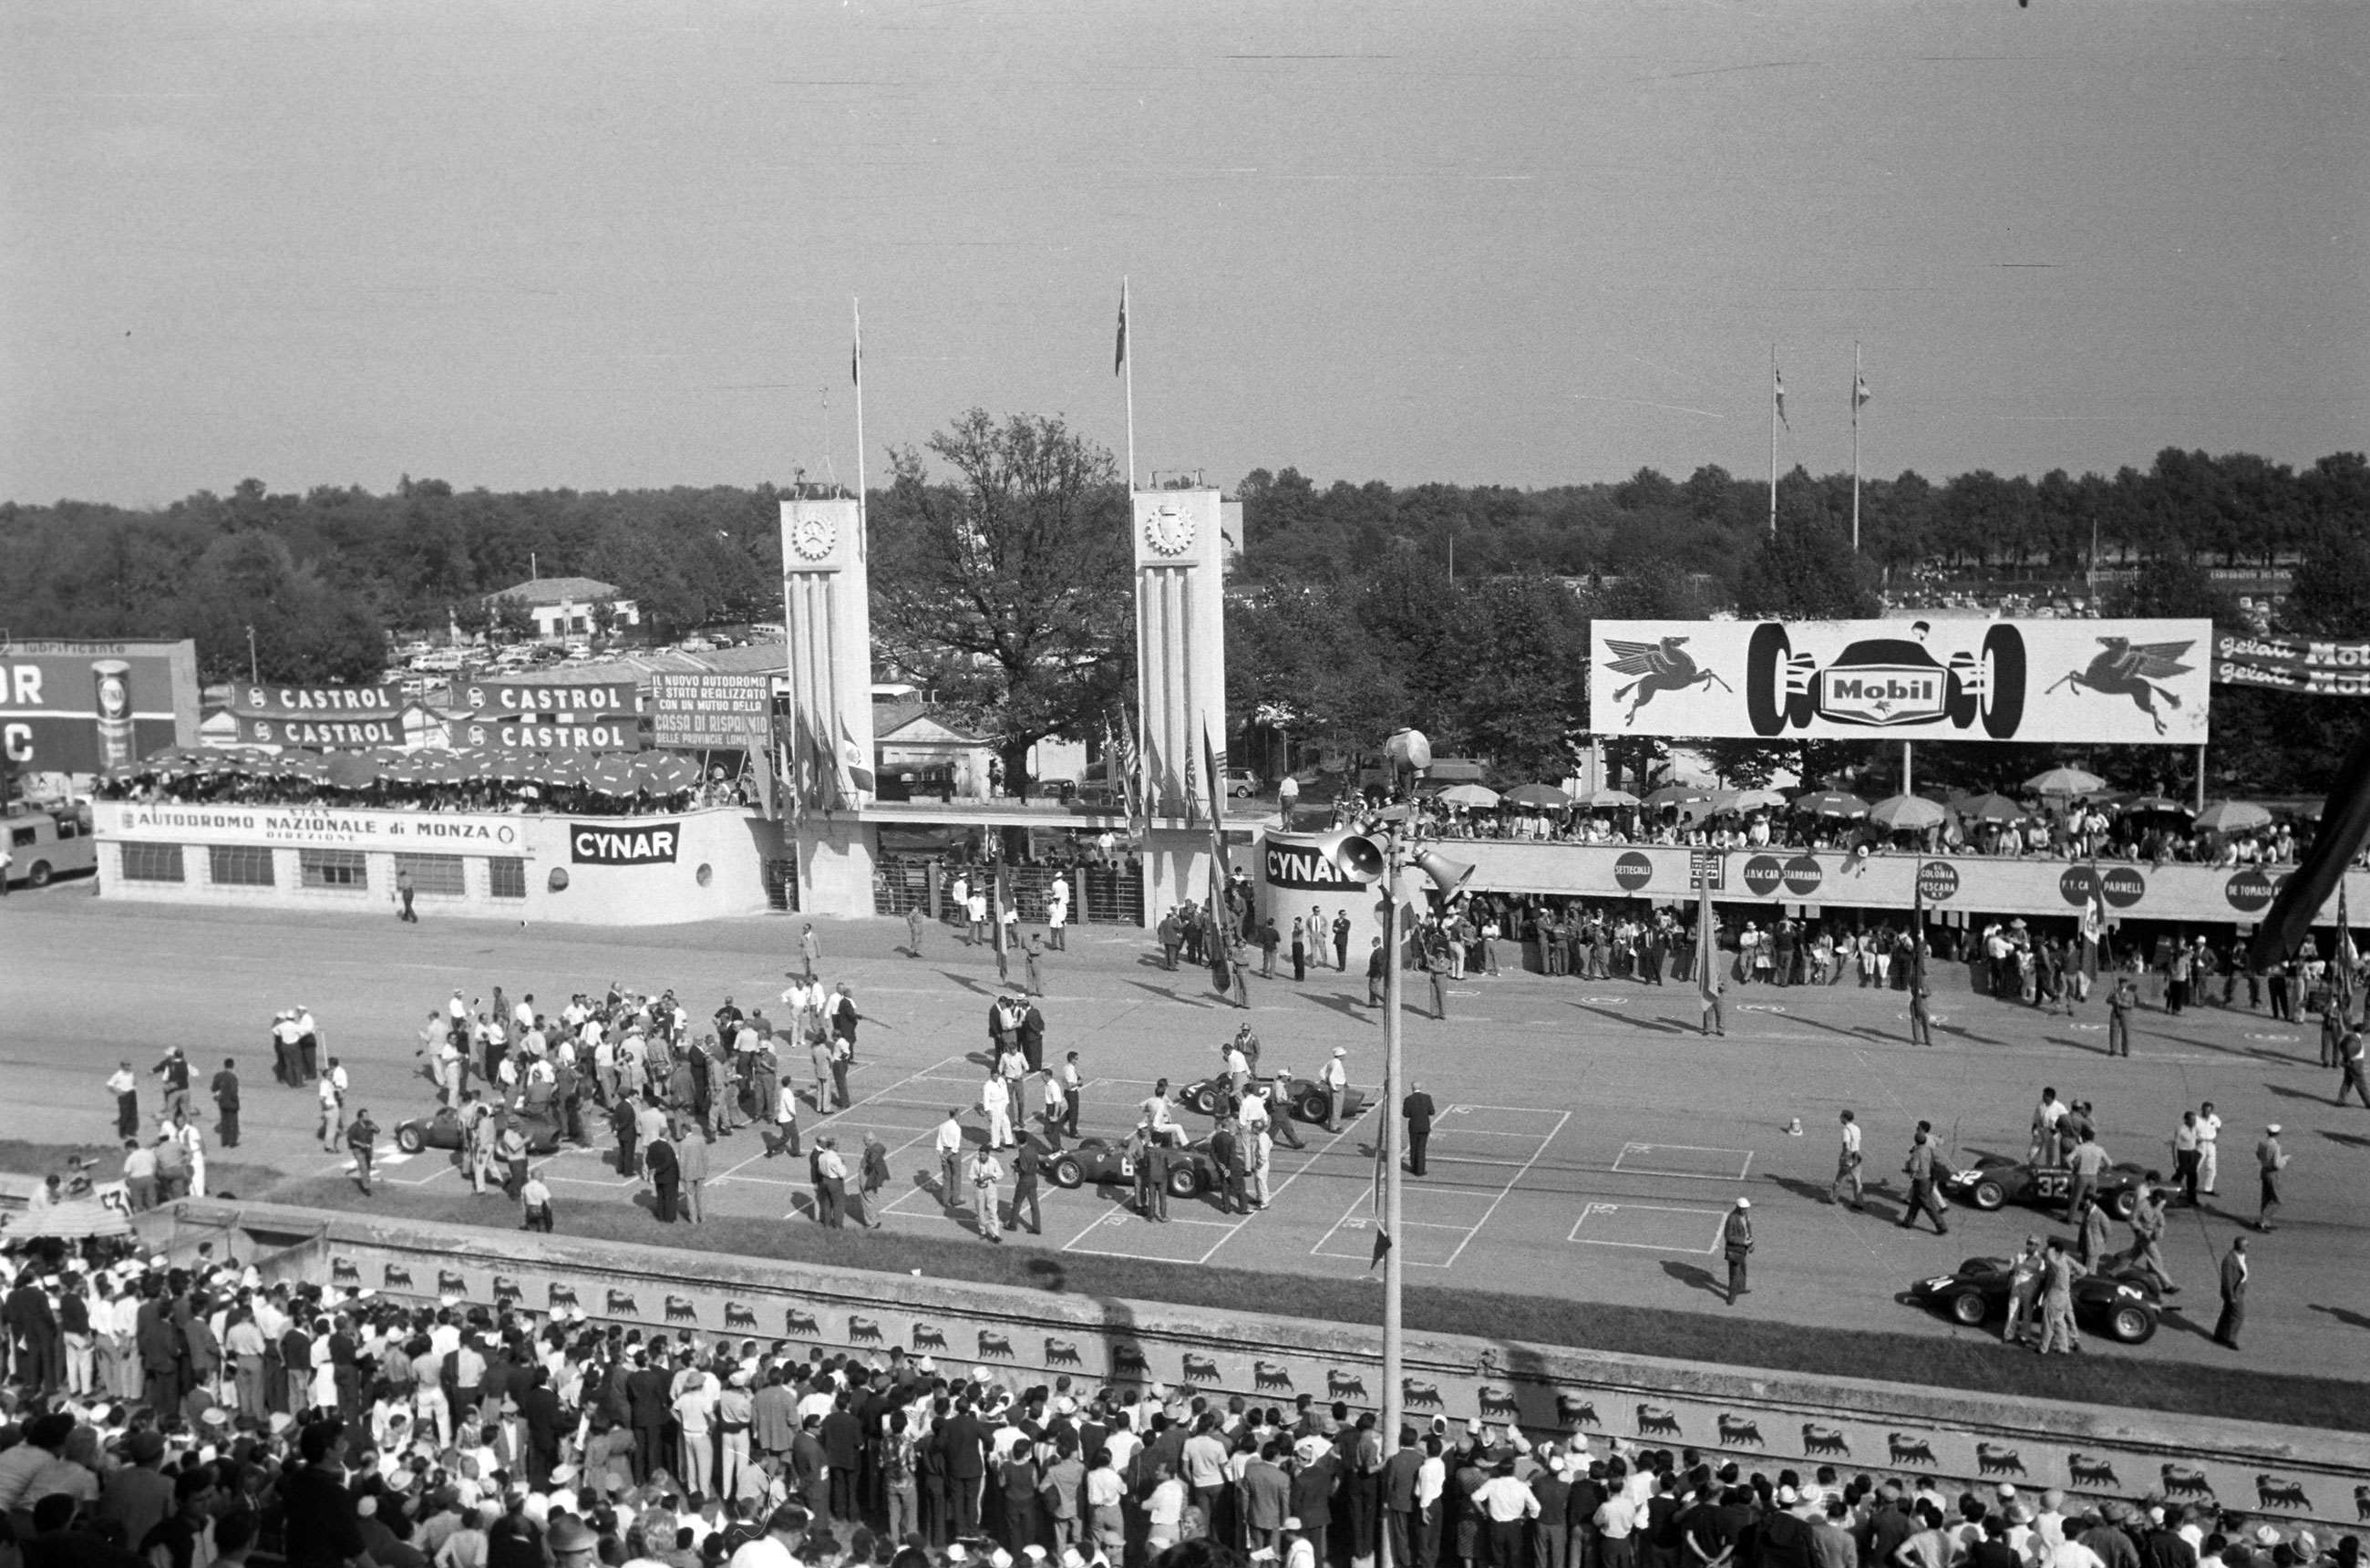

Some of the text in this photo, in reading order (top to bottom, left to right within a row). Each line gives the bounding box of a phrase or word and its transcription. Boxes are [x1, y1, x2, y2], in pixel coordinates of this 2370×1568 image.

[23, 641, 125, 655] lubrificante
[2220, 637, 2296, 658] gelati
[0, 665, 44, 704] R
[653, 675, 766, 687] IL NUOVO AUTODROMO
[1834, 679, 1932, 699] Mobil
[280, 688, 390, 708] CASTROL
[500, 688, 621, 708] CASTROL
[665, 686, 697, 698] STATO
[701, 687, 767, 699] REALIZZATO
[659, 699, 762, 711] CON UN MUTUO DELLA
[655, 714, 690, 730] CASSA
[695, 715, 706, 731] DI
[5, 723, 34, 762] C
[284, 723, 394, 743] CASTROL
[501, 727, 624, 747] CASTROL
[655, 732, 679, 744] DELLE
[139, 813, 490, 839] AUTODROMO NAZIONALE di MONZA
[576, 830, 673, 859] CYNAR
[1921, 869, 1954, 879] COLONIA
[1919, 882, 1954, 892] PESCARA
[2104, 881, 2142, 893] PARNELL
[2228, 885, 2238, 895] DE
[2241, 885, 2272, 896] TOMASO
[2037, 1176, 2068, 1197] 32
